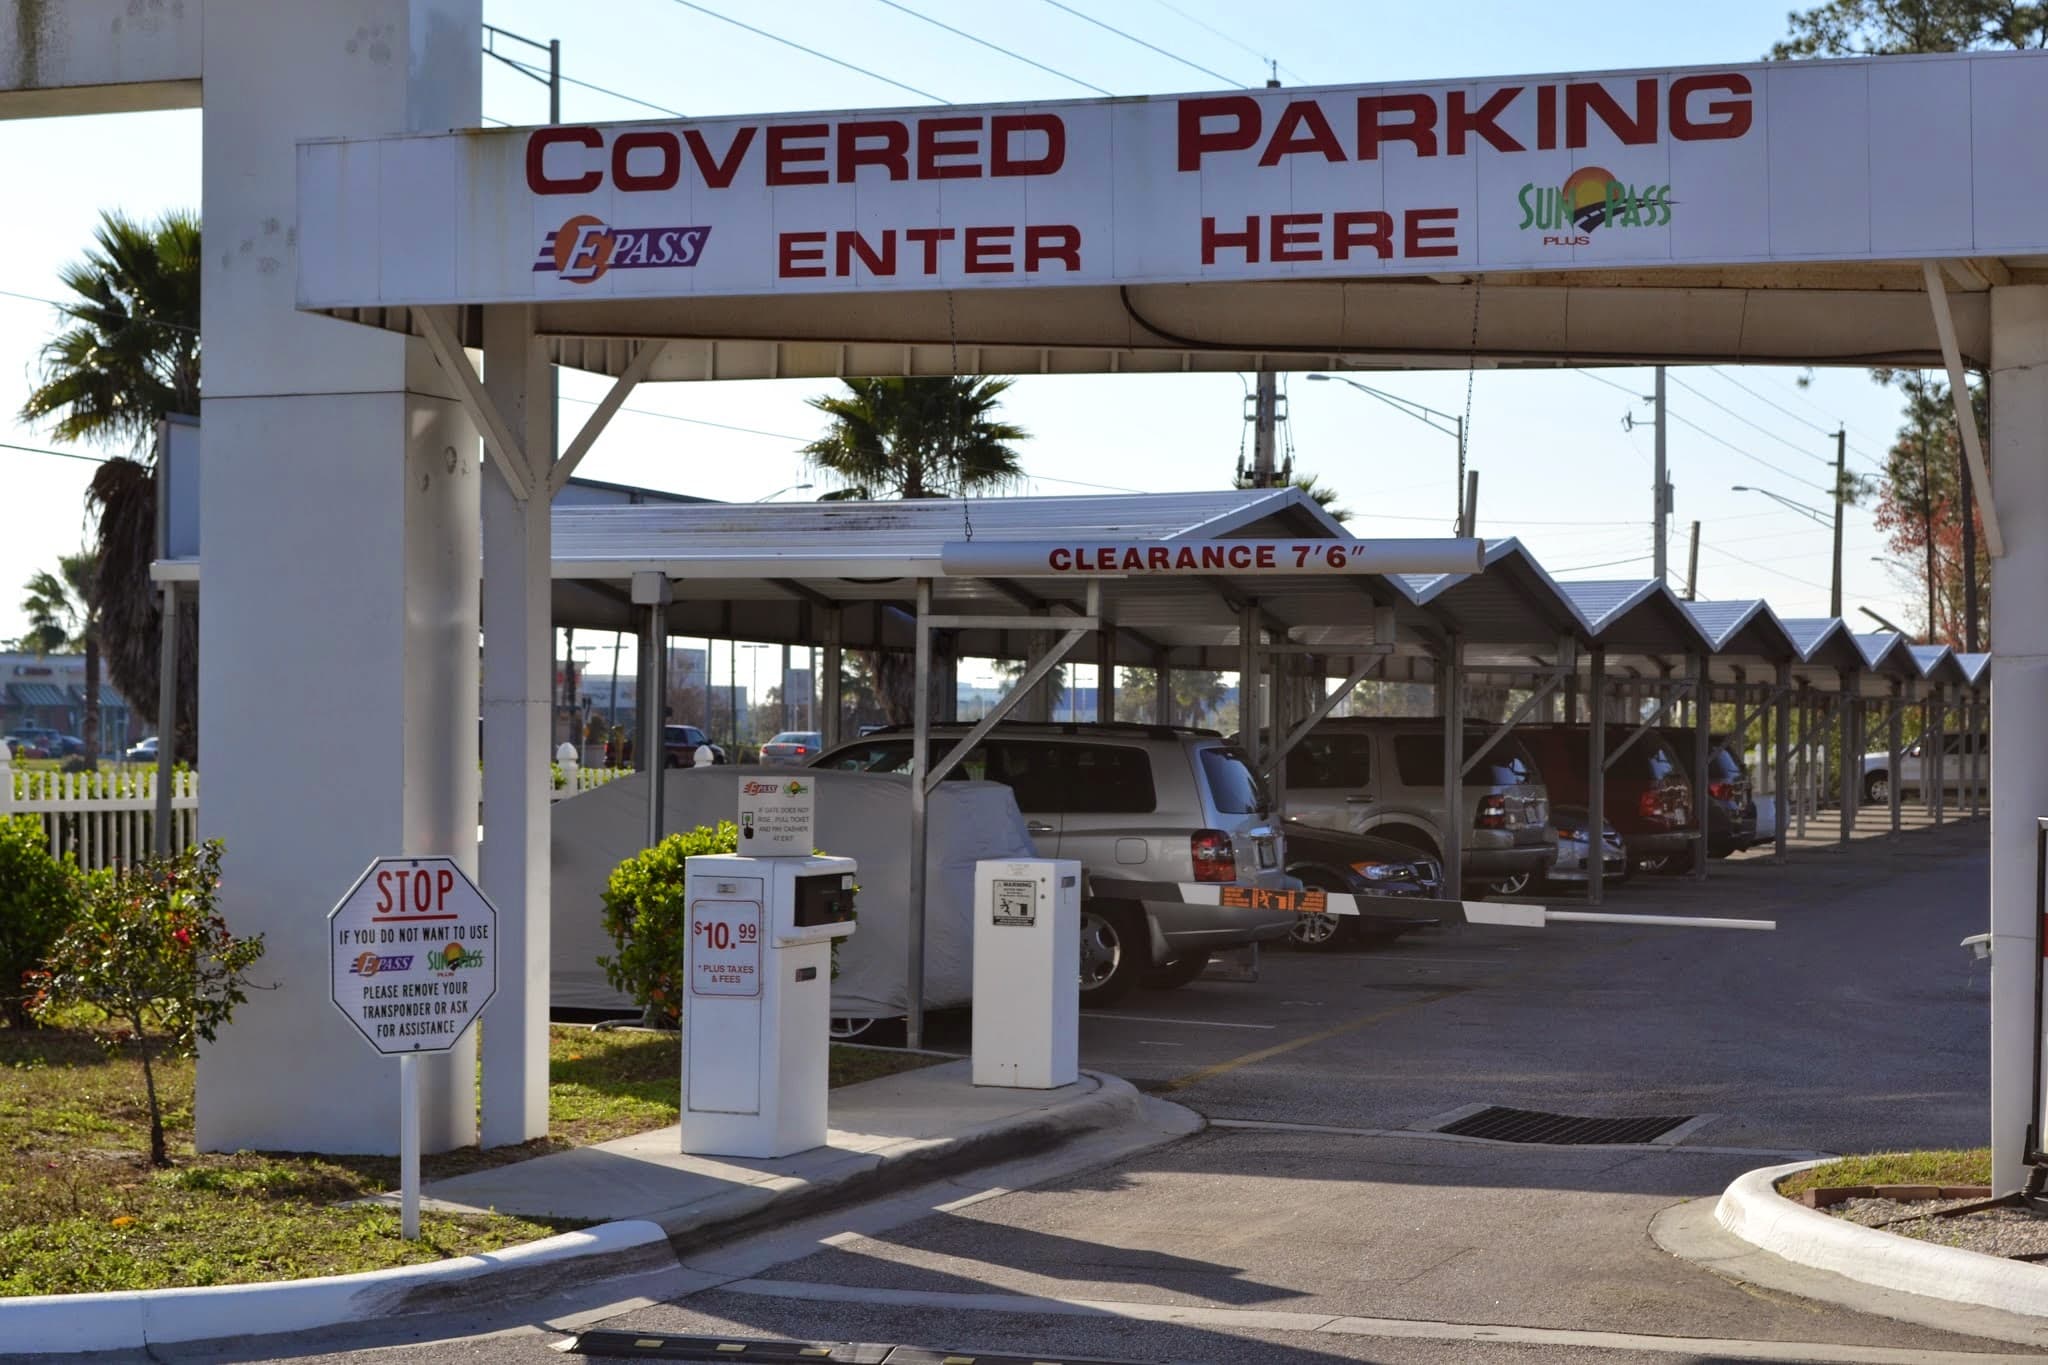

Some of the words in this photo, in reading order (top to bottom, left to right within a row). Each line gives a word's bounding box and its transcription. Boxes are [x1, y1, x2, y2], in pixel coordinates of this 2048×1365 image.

[525, 113, 1066, 197] COVERED
[1177, 73, 1753, 172] PARKING
[779, 224, 1081, 278] ENTER
[1201, 207, 1459, 265] HERE
[1543, 236, 1591, 246] PLUS
[1049, 545, 1276, 571] CLEARANCE
[376, 869, 454, 913] STOP
[339, 930, 350, 945] IF
[354, 929, 375, 944] YOU
[381, 928, 394, 943] DO
[399, 927, 418, 942] NOT
[422, 926, 449, 941] WANT
[454, 926, 465, 940] TO
[469, 925, 489, 939] USE
[703, 964, 725, 973] PLUS
[728, 965, 754, 974] TAXES
[719, 975, 741, 984] FEES
[363, 984, 398, 1000] PLEASE
[402, 982, 440, 997] REMOVE
[442, 981, 468, 996] YOUR
[363, 1003, 431, 1019] TRANSPONDER
[434, 1001, 447, 1015] OR
[450, 1001, 468, 1014] ASK
[377, 1024, 395, 1038] FOR
[399, 1020, 455, 1037] ASSISTANCE
